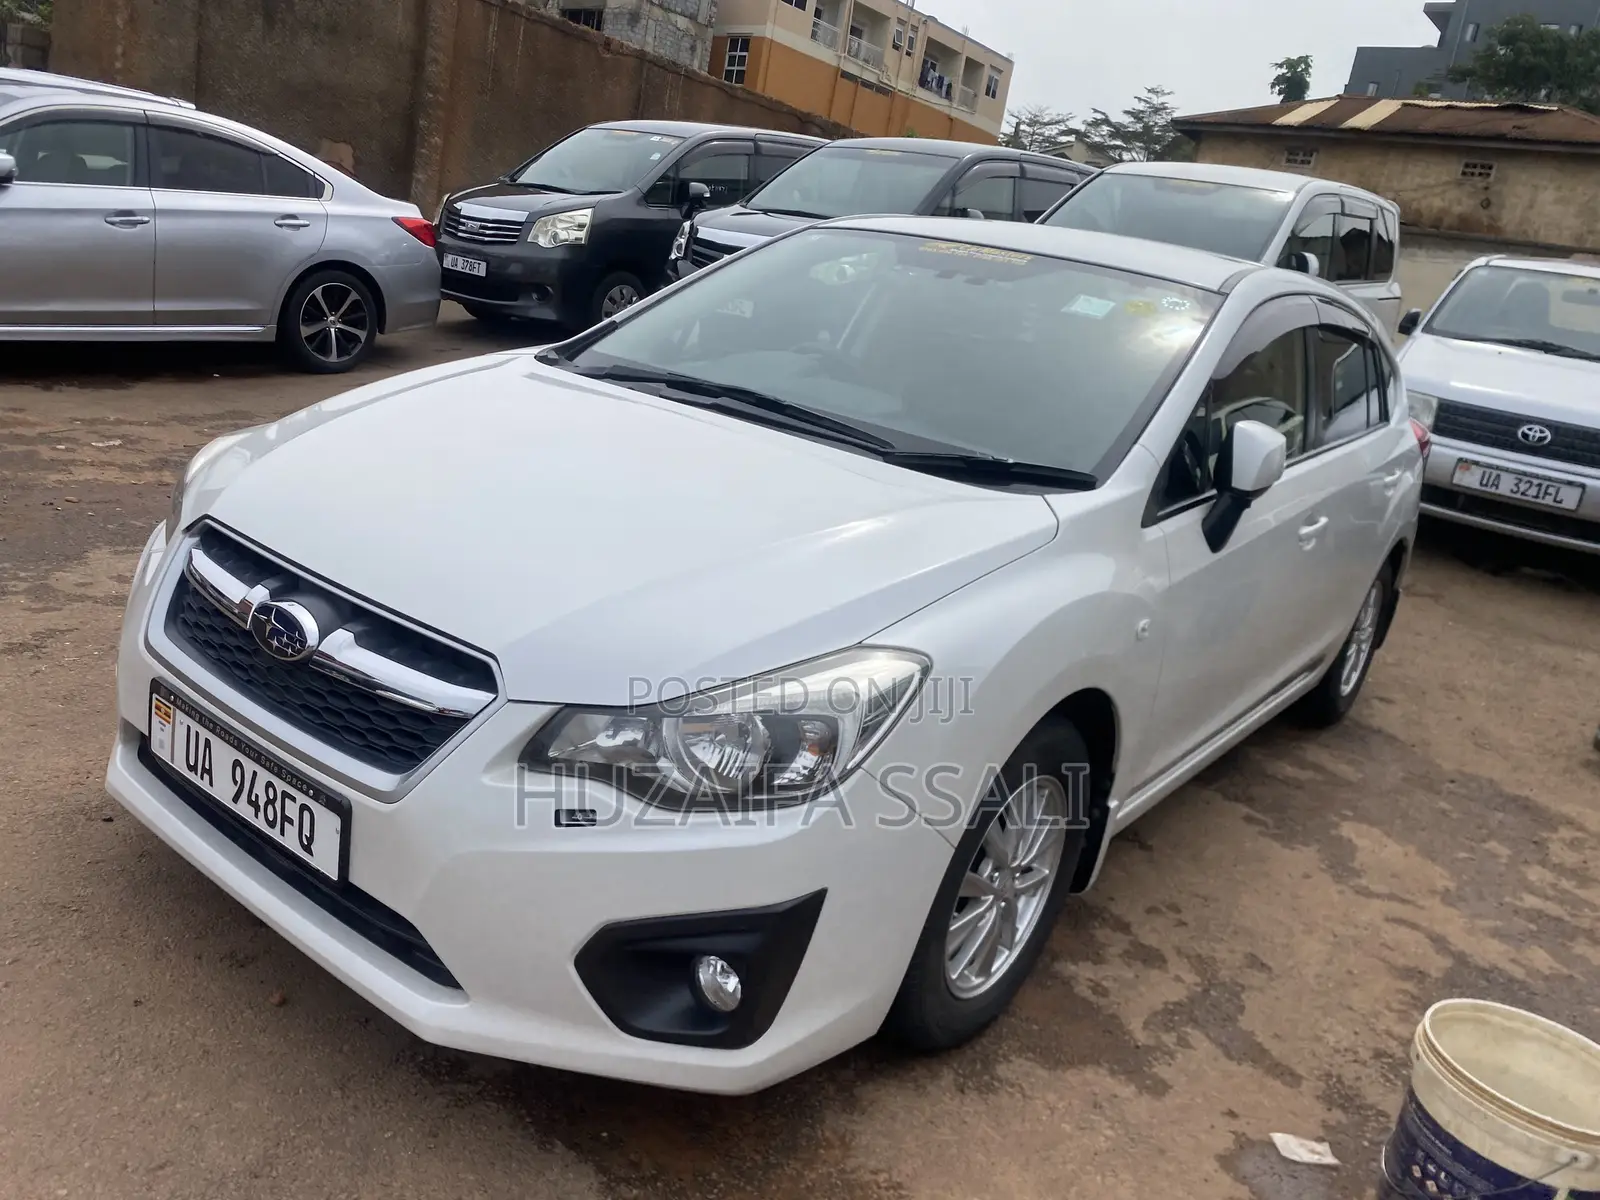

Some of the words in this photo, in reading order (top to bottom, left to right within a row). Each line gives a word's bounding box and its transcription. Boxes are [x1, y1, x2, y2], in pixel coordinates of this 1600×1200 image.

[450, 256, 459, 269] UA
[1479, 469, 1501, 491] UA
[1509, 476, 1564, 505] 321FL
[176, 698, 200, 721] Making
[215, 727, 239, 747] Roads
[240, 743, 258, 759] Your
[260, 755, 279, 774] Safe
[280, 769, 308, 792] Space
[185, 723, 214, 788] UA
[230, 757, 316, 858] 948FQ
